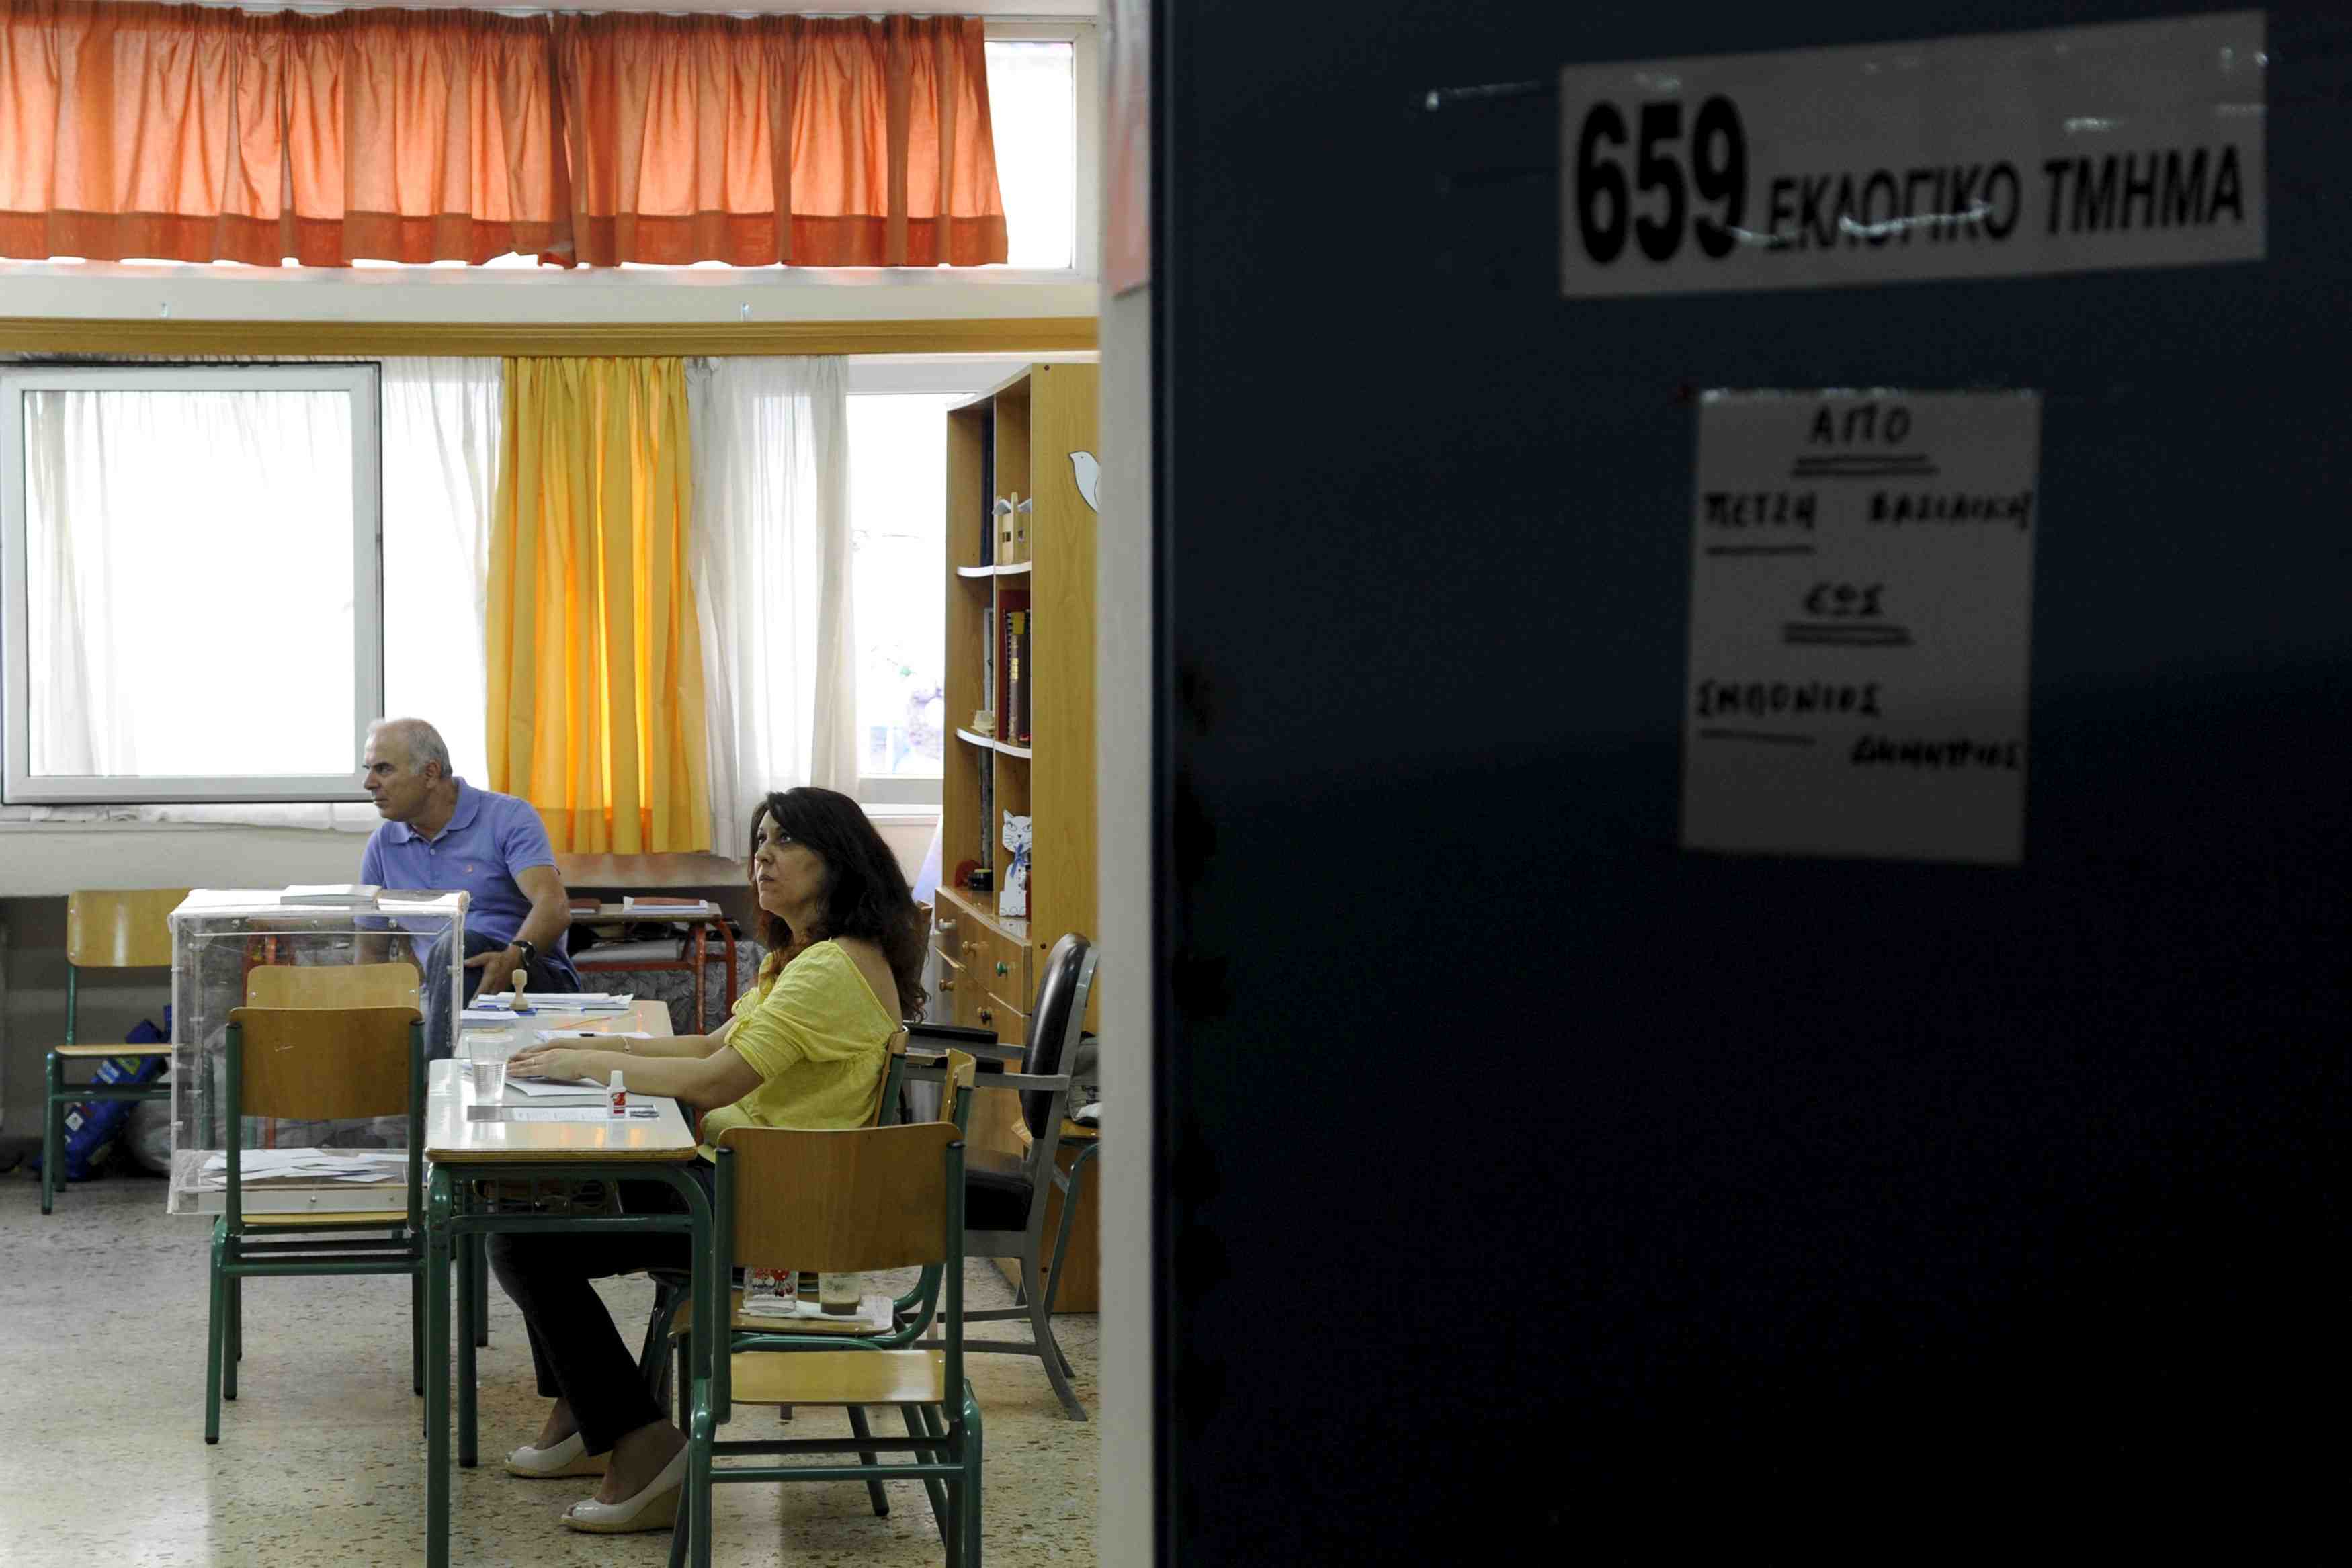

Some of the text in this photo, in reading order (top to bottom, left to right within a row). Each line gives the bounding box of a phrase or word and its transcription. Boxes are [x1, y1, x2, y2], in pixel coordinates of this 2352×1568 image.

[1574, 93, 2245, 265] 659 ΕΚΛΟΓΙΚΟ ΤΜΗΜΑ
[1807, 402, 1913, 445] ΑΠΟ
